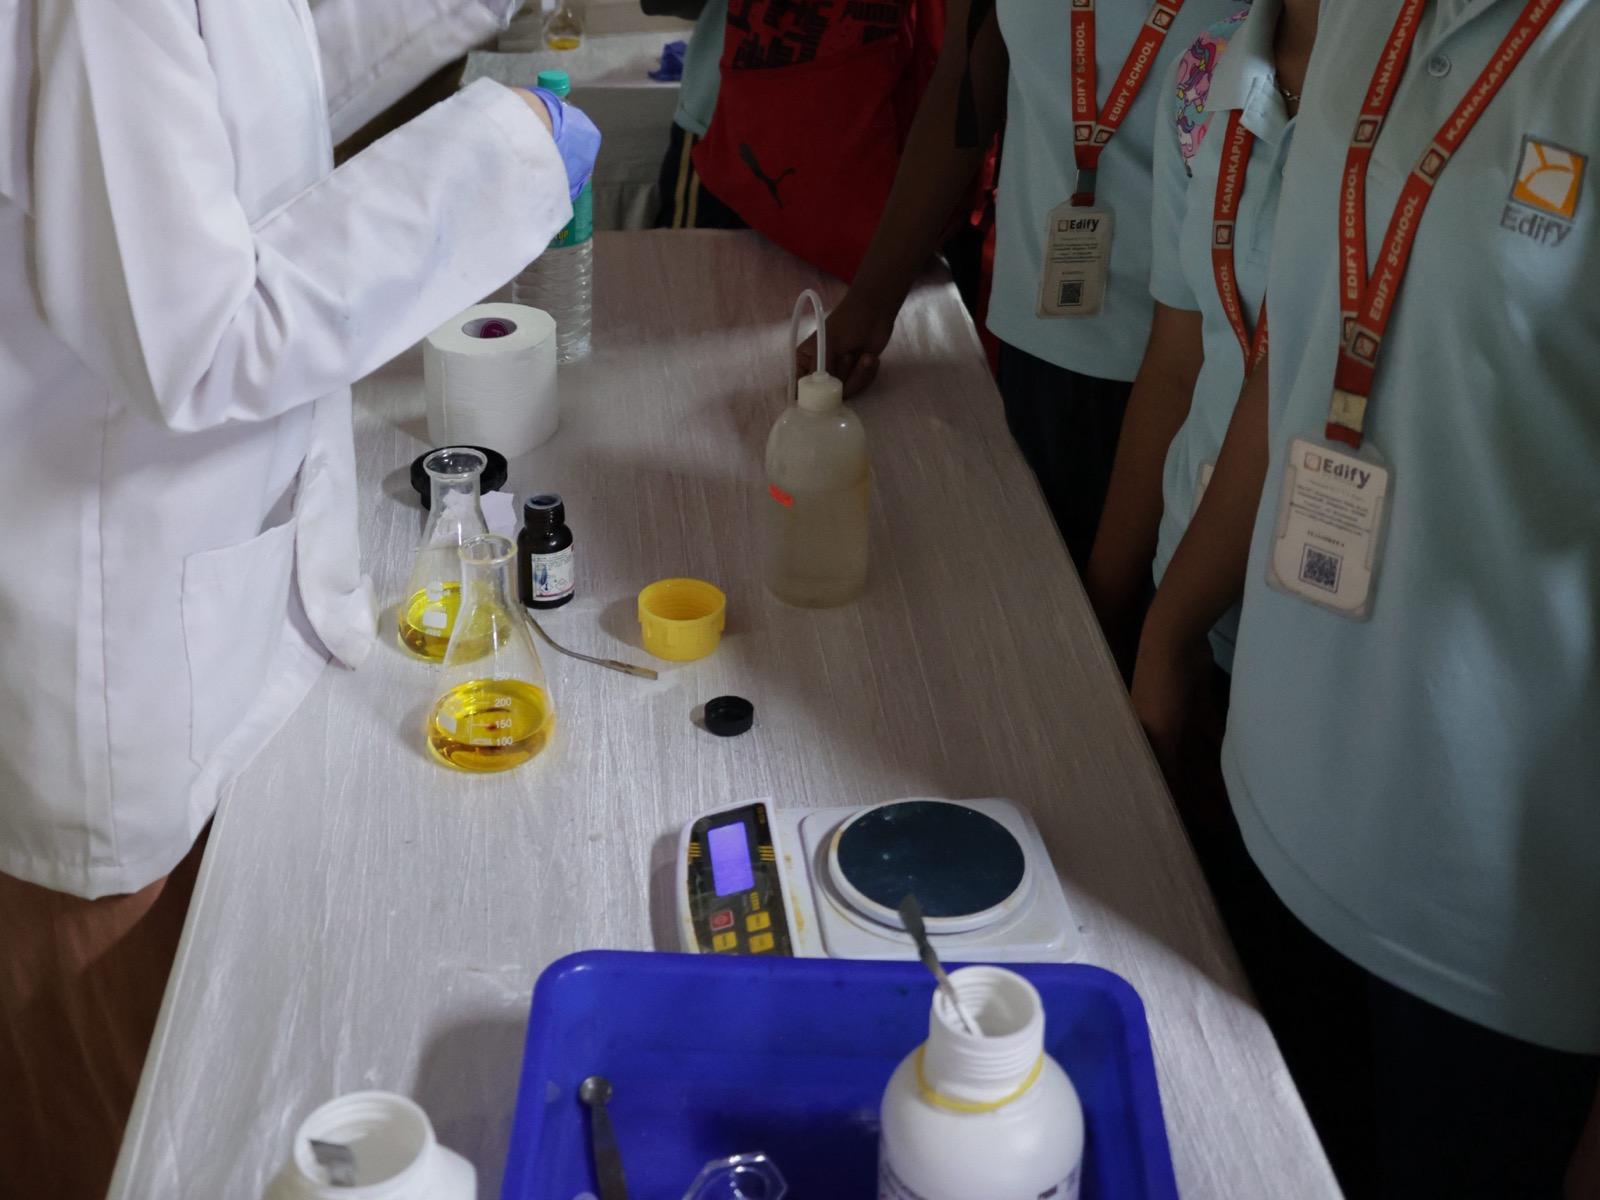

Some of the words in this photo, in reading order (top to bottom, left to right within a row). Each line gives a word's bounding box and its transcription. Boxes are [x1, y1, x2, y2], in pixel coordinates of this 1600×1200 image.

[1076, 22, 1086, 72] SCHOOL
[1076, 75, 1087, 113] EDIFY
[1109, 84, 1132, 122] EDIFY
[1125, 39, 1155, 87] SCHOOL
[1446, 25, 1532, 141] KANAKAPURA
[1345, 162, 1359, 239] SCHOOL
[1070, 219, 1100, 232] Edify
[1500, 204, 1572, 248] Edify
[1346, 245, 1358, 300] EDIFY
[1369, 265, 1393, 321] EDIFY
[1387, 196, 1419, 266] SCHOOL
[1220, 263, 1238, 322] SCHOOL
[1322, 457, 1371, 489] Edify
[495, 696, 512, 707] 200
[495, 718, 513, 729] 150
[496, 735, 513, 746] 100
